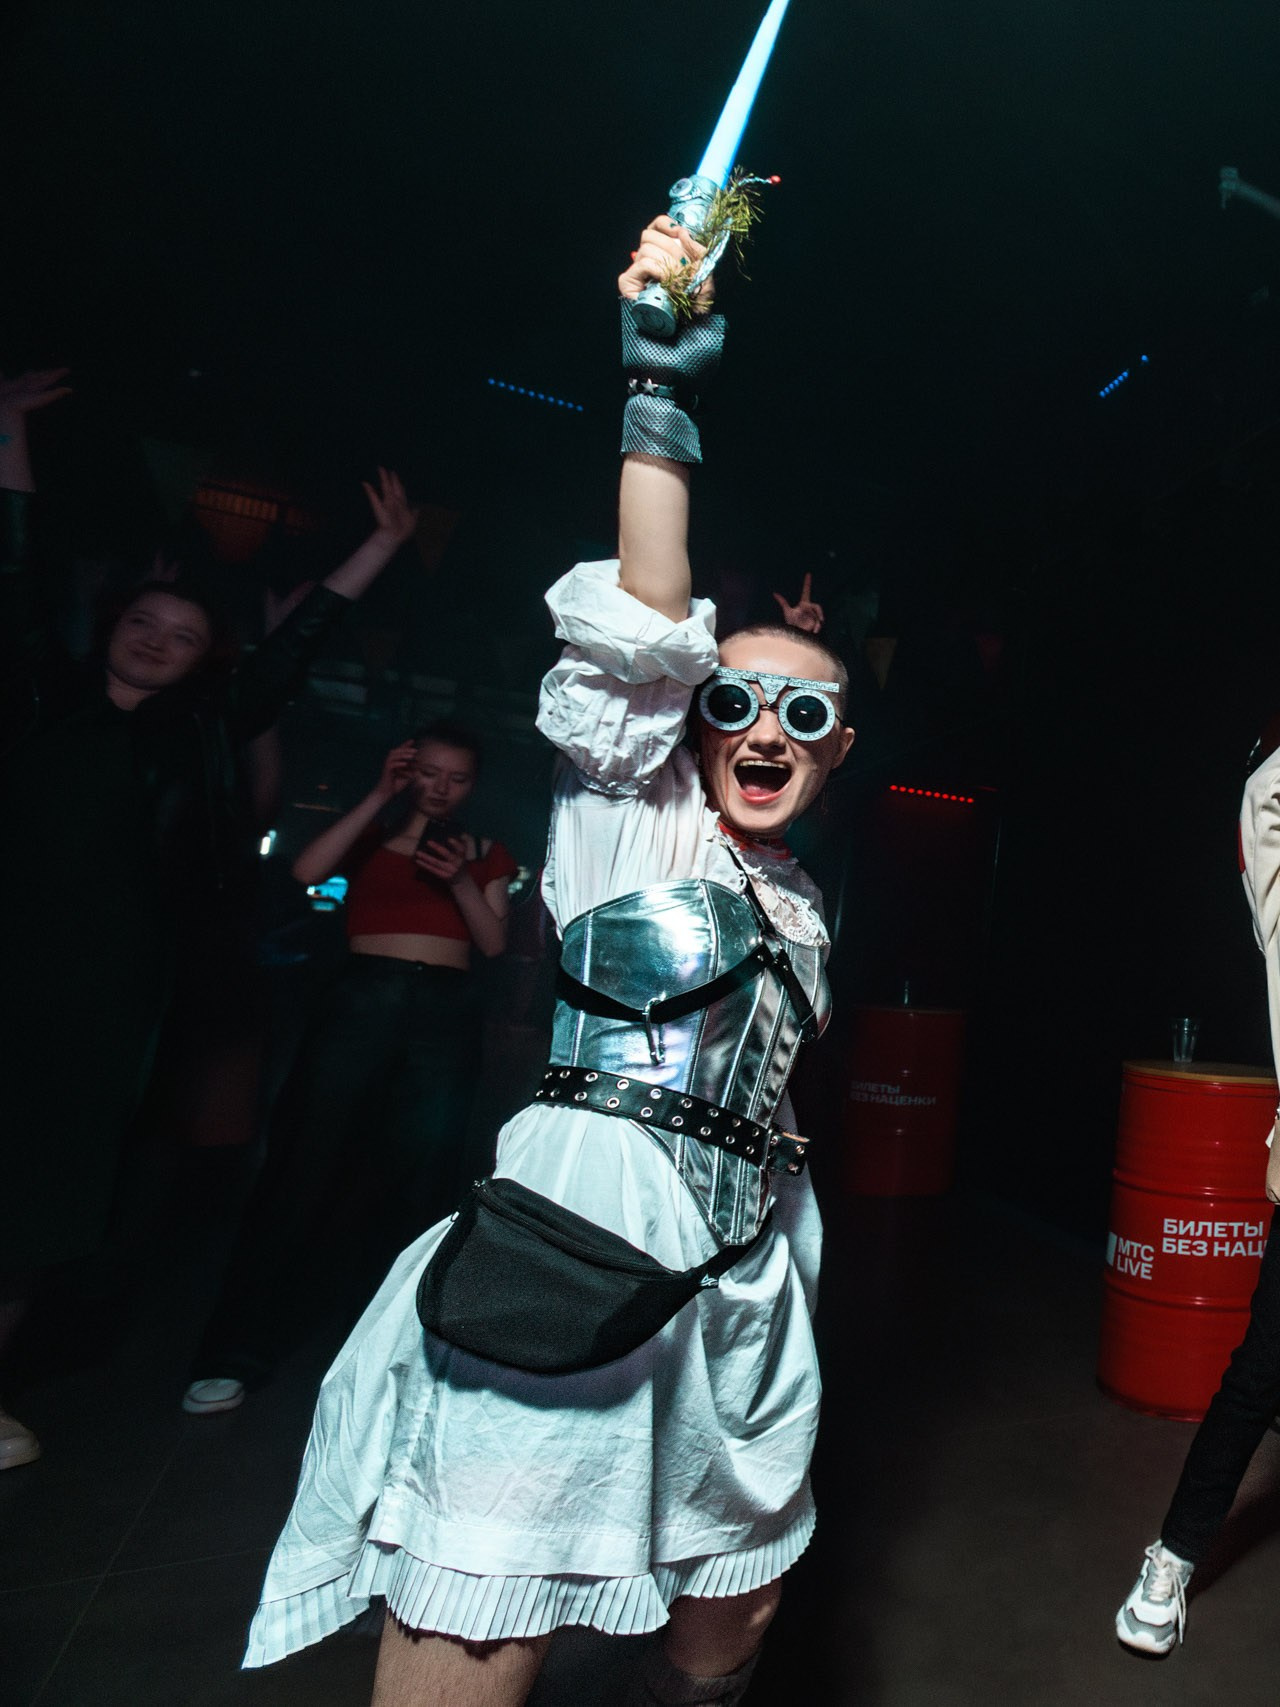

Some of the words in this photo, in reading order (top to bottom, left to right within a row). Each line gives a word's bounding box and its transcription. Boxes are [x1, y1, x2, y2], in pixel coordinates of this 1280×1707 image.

[1162, 1217, 1264, 1238] БИЛЕТЫ
[1117, 1236, 1155, 1262] МТС
[1161, 1236, 1209, 1257] БЕЗ
[1212, 1239, 1268, 1258] НАЦ
[1116, 1253, 1154, 1281] LIVE
